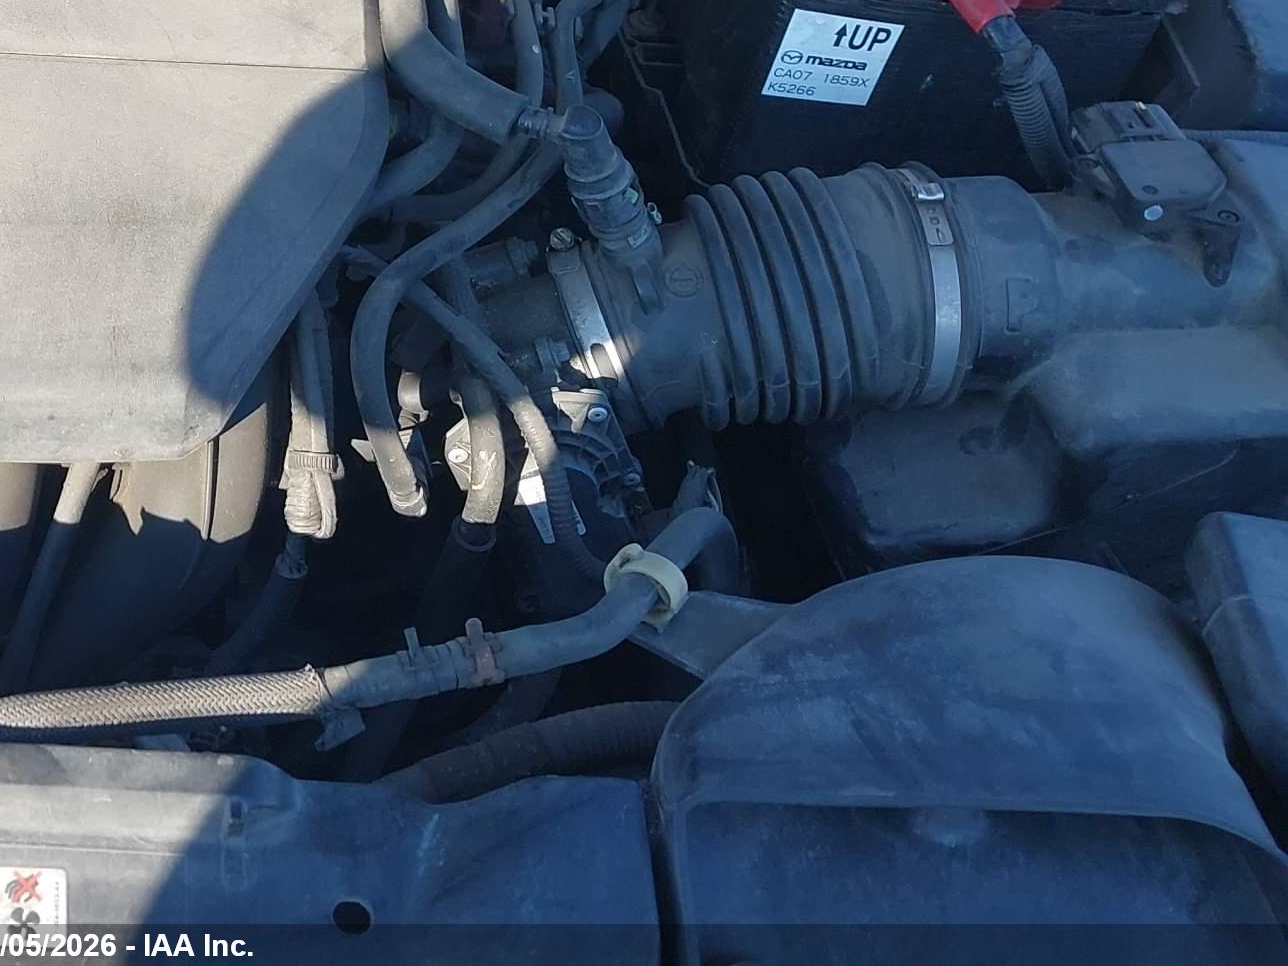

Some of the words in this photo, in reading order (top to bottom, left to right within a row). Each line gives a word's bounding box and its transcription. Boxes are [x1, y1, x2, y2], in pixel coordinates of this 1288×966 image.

[848, 24, 892, 51] UP
[805, 55, 868, 71] mazda
[767, 82, 816, 96] K5266
